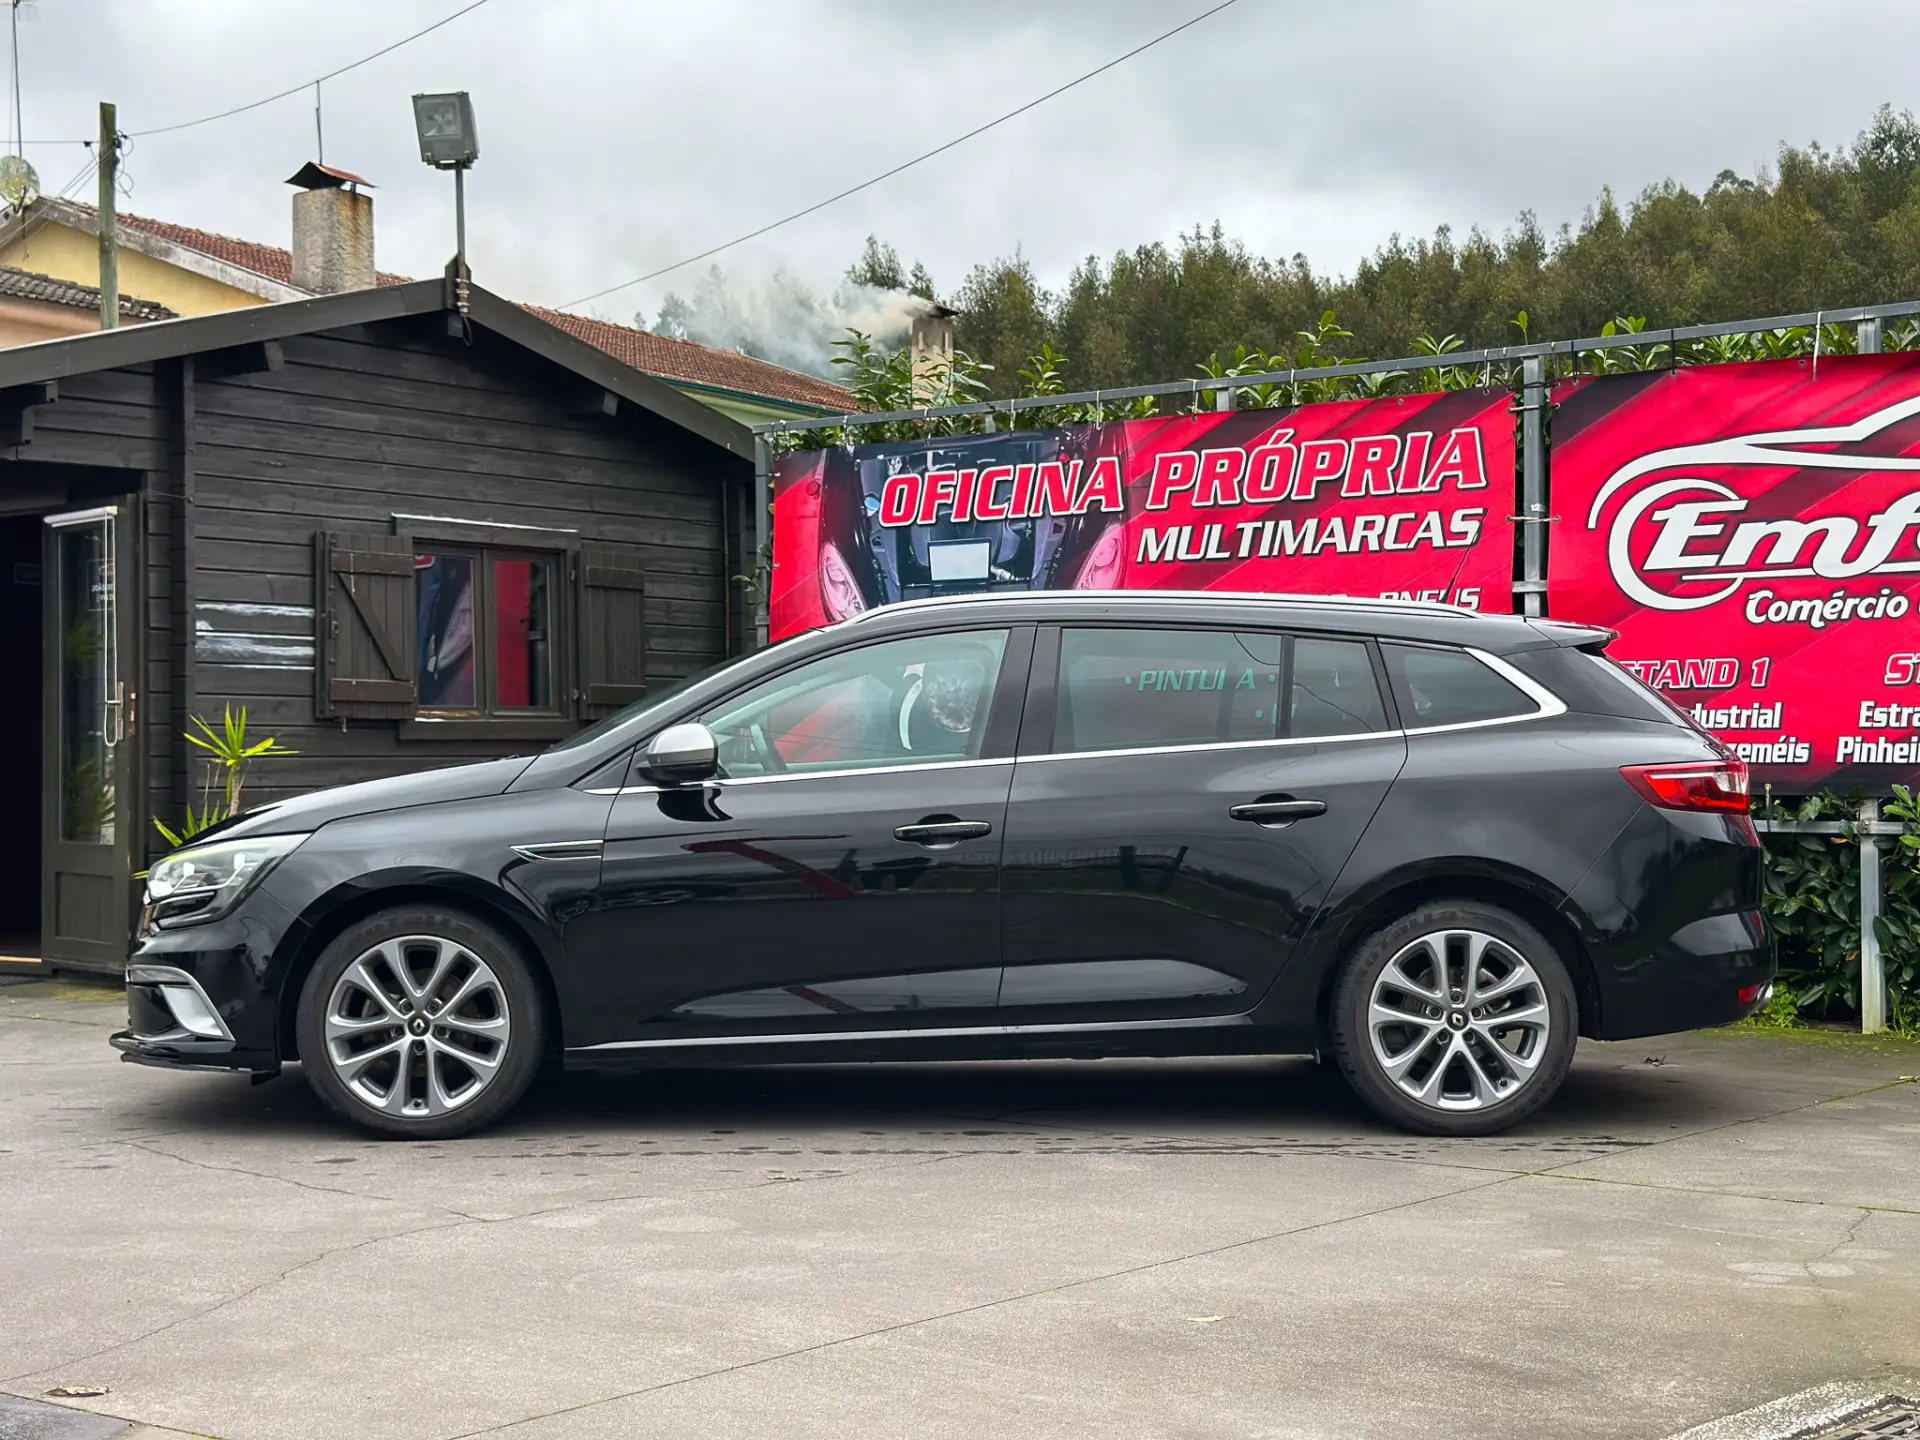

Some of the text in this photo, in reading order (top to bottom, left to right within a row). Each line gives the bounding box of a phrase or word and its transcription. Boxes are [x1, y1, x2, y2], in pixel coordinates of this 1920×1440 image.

[879, 428, 1487, 528] OFICINA PRÓPRIA
[1136, 507, 1484, 563] MULTIMARCAS
[1745, 588, 1909, 628] Comércio
[1751, 657, 1771, 688] 1
[1836, 736, 1920, 763] Pinhei
